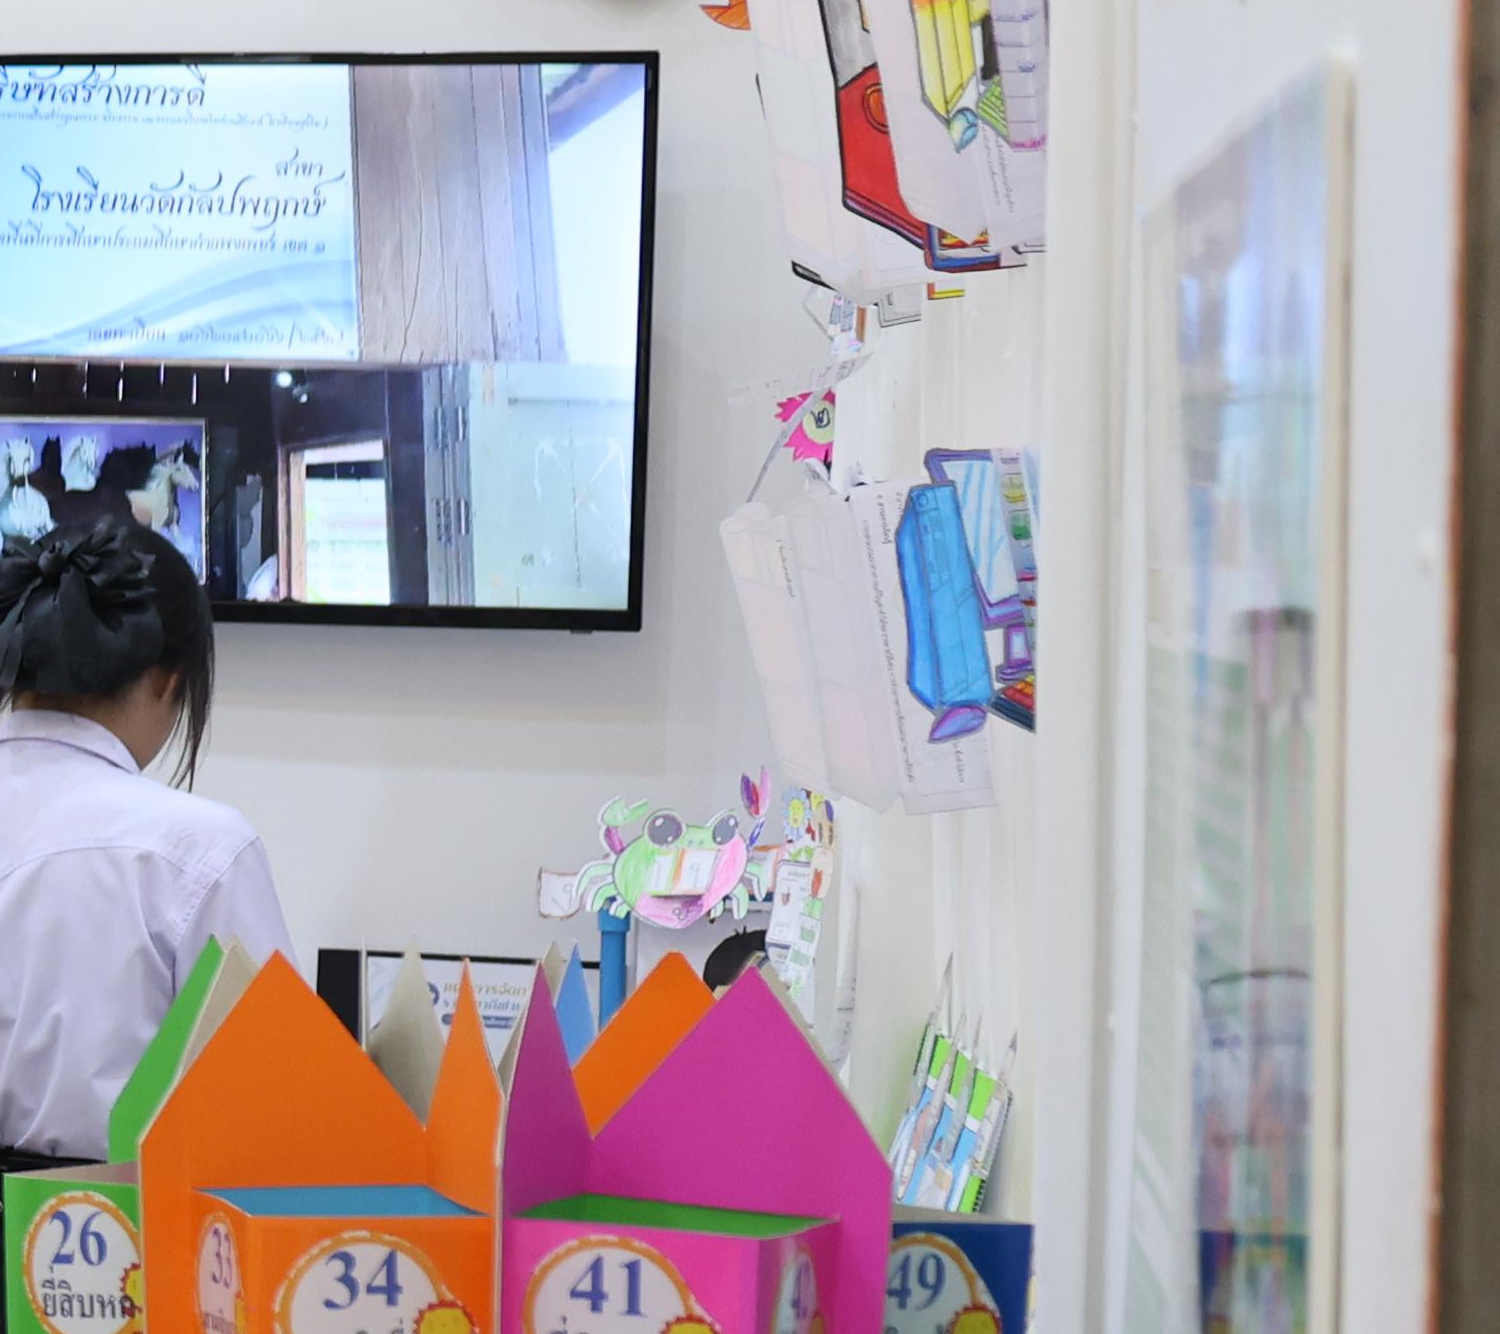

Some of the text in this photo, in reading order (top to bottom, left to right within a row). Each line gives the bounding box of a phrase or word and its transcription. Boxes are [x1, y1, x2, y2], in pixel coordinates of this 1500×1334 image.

[21, 165, 346, 232] โรงเรียนวัดกัลปพฤกษ์
[49, 1210, 109, 1268] 26
[211, 1226, 233, 1289] 33
[323, 1248, 404, 1311] 34
[571, 1254, 647, 1318] 41
[887, 1253, 946, 1310] 49
